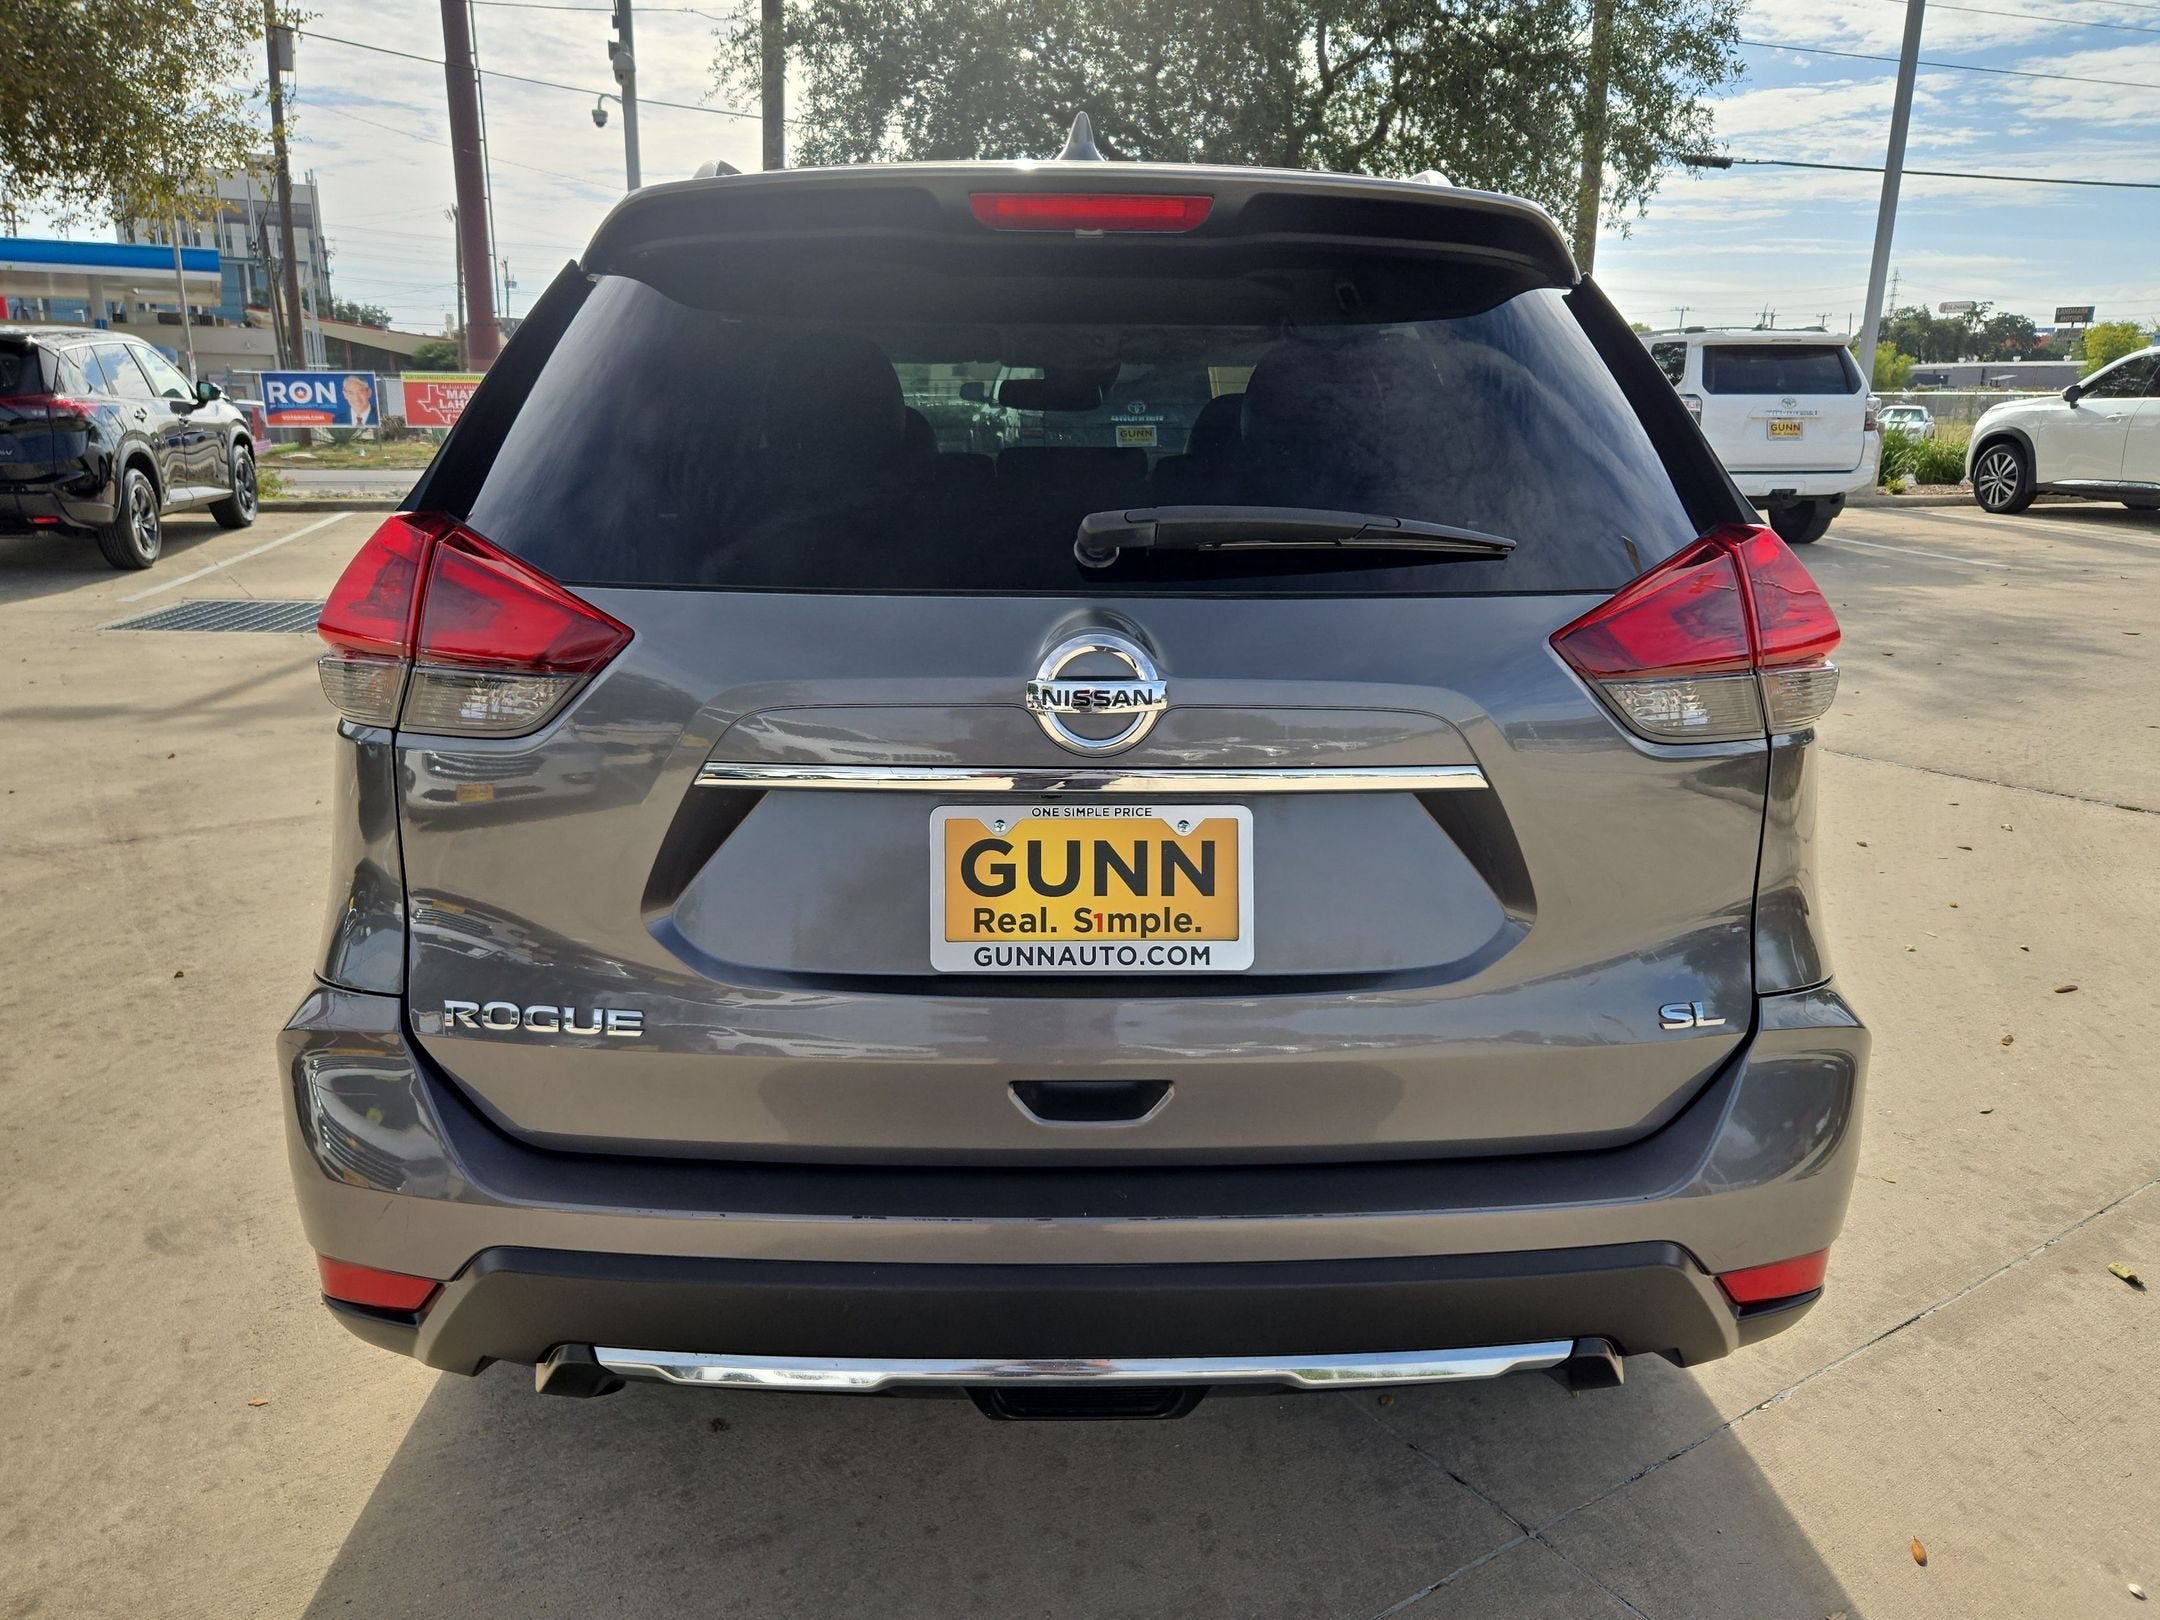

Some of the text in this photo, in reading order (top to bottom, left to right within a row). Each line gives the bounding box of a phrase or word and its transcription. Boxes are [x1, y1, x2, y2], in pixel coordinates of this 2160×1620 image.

[266, 381, 337, 404] RON
[1120, 429, 1153, 438] GUNN
[1770, 423, 1801, 432] GUNN
[1041, 688, 1153, 707] NISSAN
[1031, 807, 1152, 817] ONE SIMPLE PRICE
[960, 838, 1216, 898] GUNN
[973, 906, 1058, 934] Real.
[973, 946, 1211, 967] GUNNAUTO.COM
[443, 999, 646, 1037] ROGUE
[1658, 1001, 1727, 1030] SL
